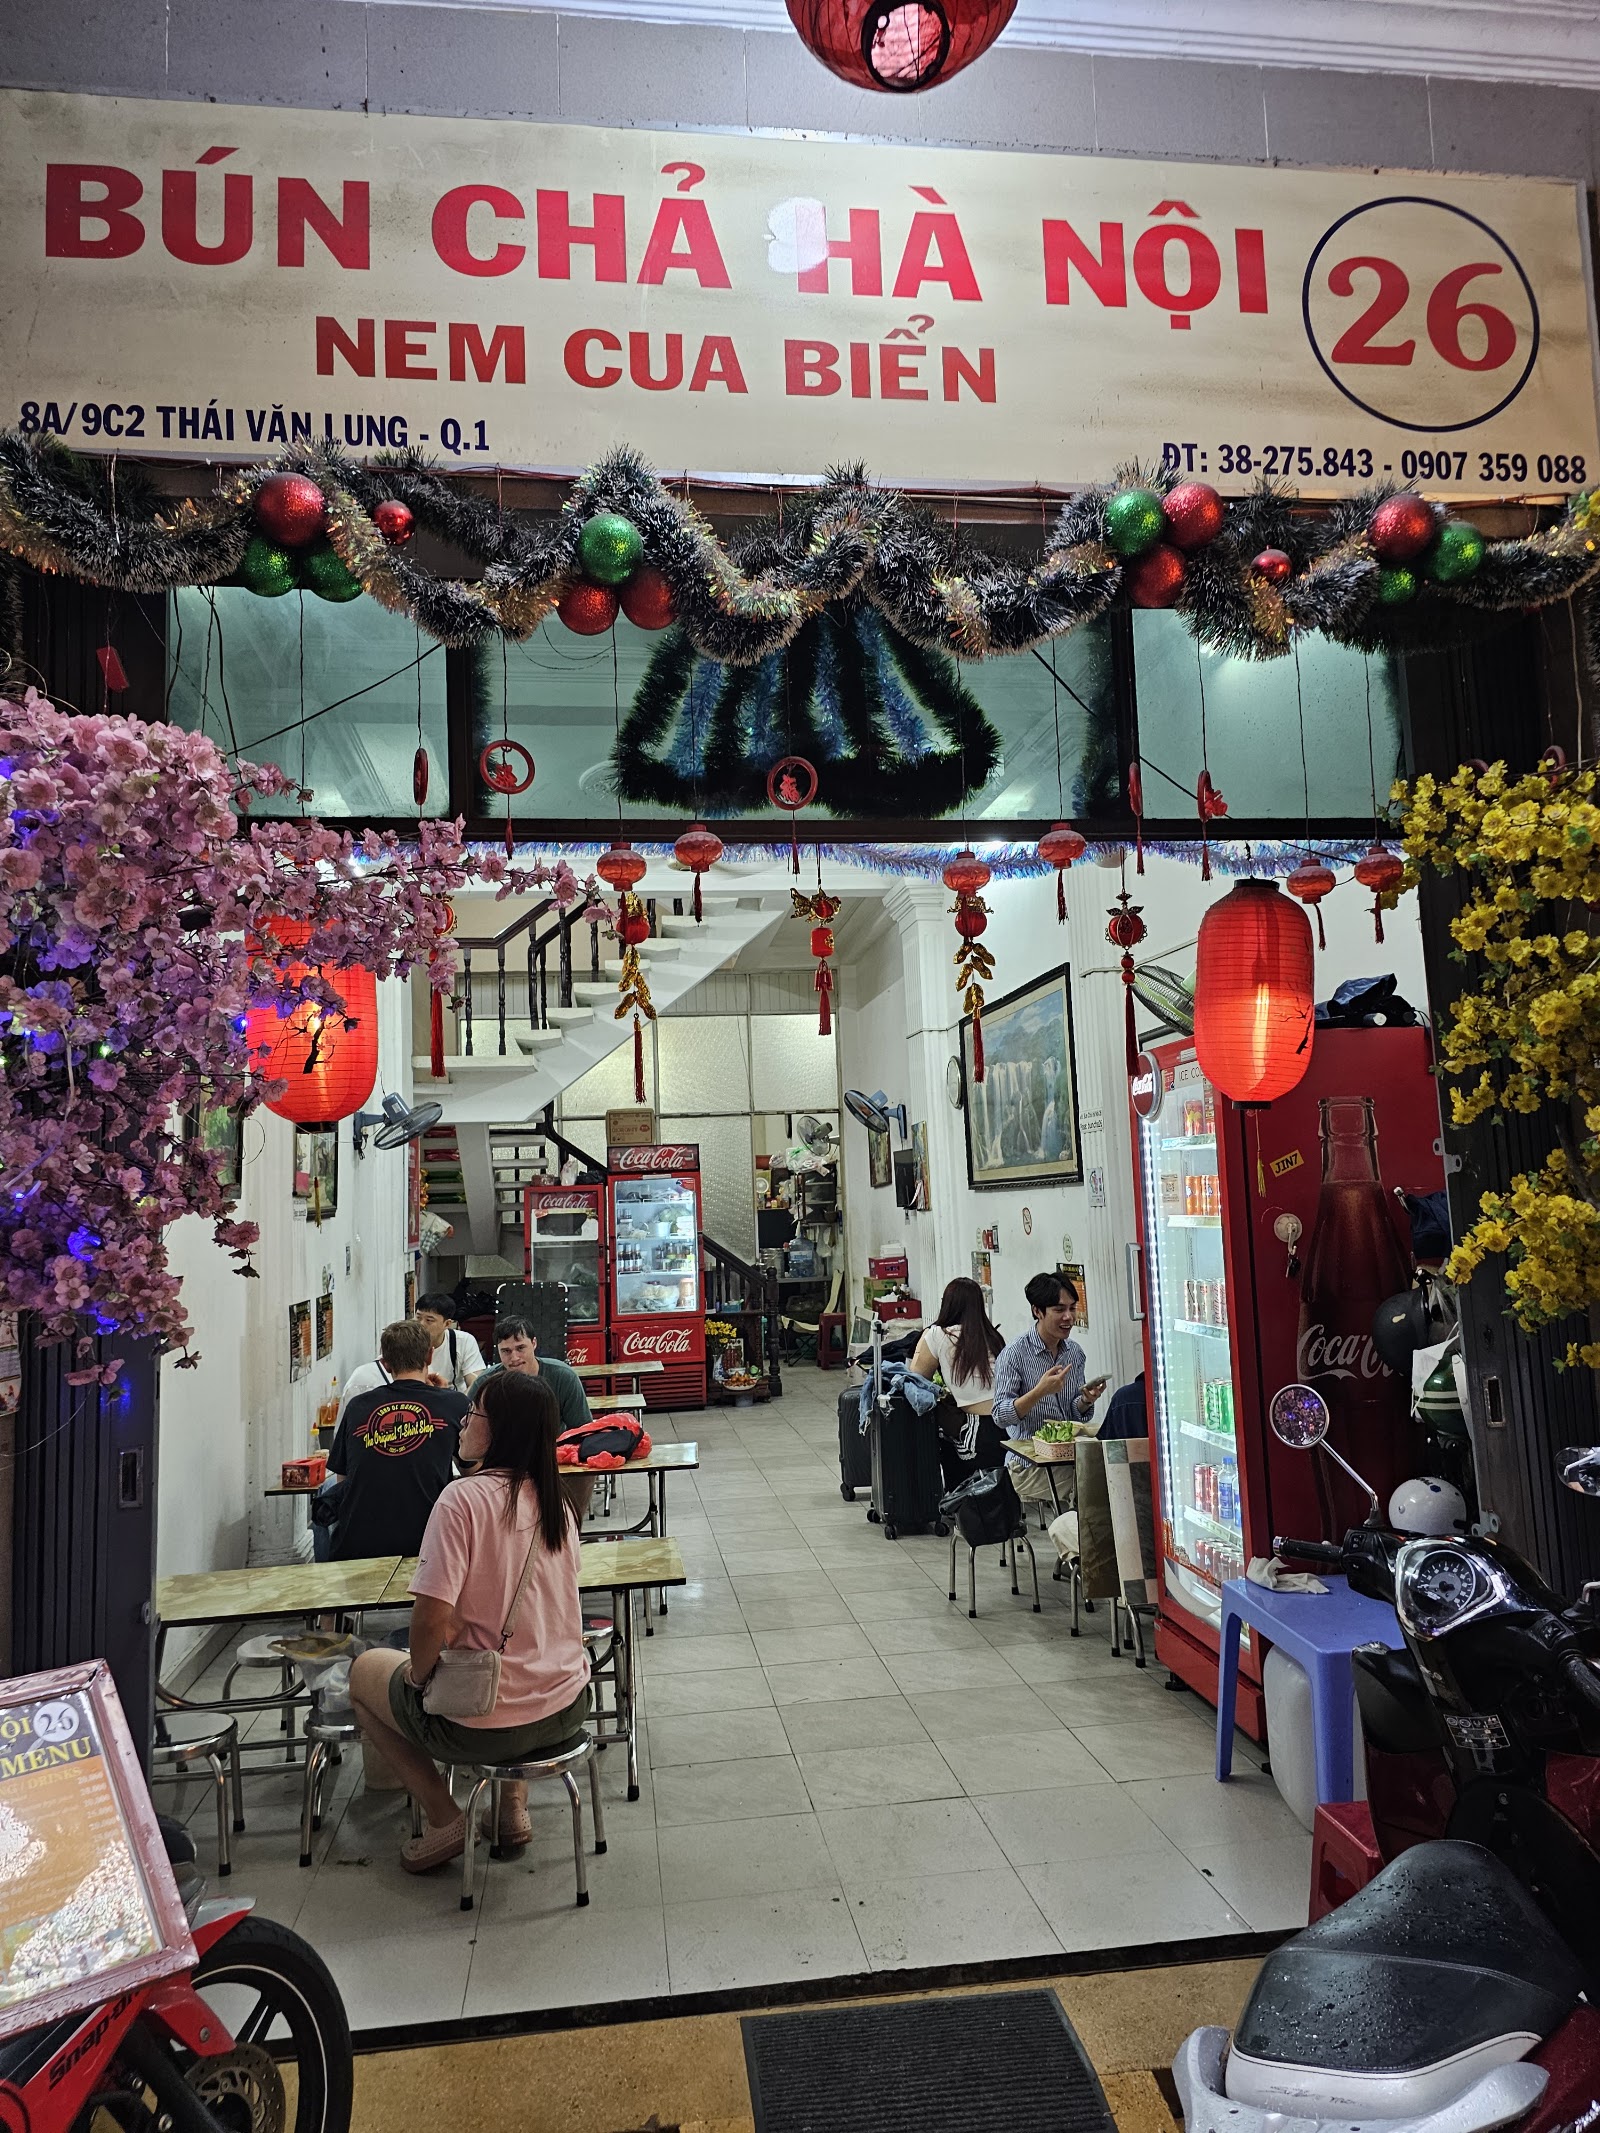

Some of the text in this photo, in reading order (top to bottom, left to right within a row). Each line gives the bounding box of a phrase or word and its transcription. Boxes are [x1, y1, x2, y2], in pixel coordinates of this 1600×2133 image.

[47, 147, 1517, 371] BÚN CHẢ HÀ NỘI 26
[317, 314, 996, 403] NEM CUA BIỂN
[20, 401, 145, 438] 8A/9C2
[156, 399, 235, 442] THÁI
[246, 403, 312, 444] VĂN
[440, 417, 490, 453] Q.1
[1162, 443, 1208, 473] ĐT:
[1217, 444, 1374, 478] 38-275.843
[1401, 449, 1468, 481] 0907
[1479, 453, 1528, 483] 359
[1537, 454, 1587, 485] 088
[620, 1147, 687, 1170] Coca-Cola
[539, 1193, 591, 1210] Coca-Cola
[623, 1328, 693, 1356] Coca-Cola
[39, 1706, 74, 1734] 26
[0, 1735, 92, 1779] MENU
